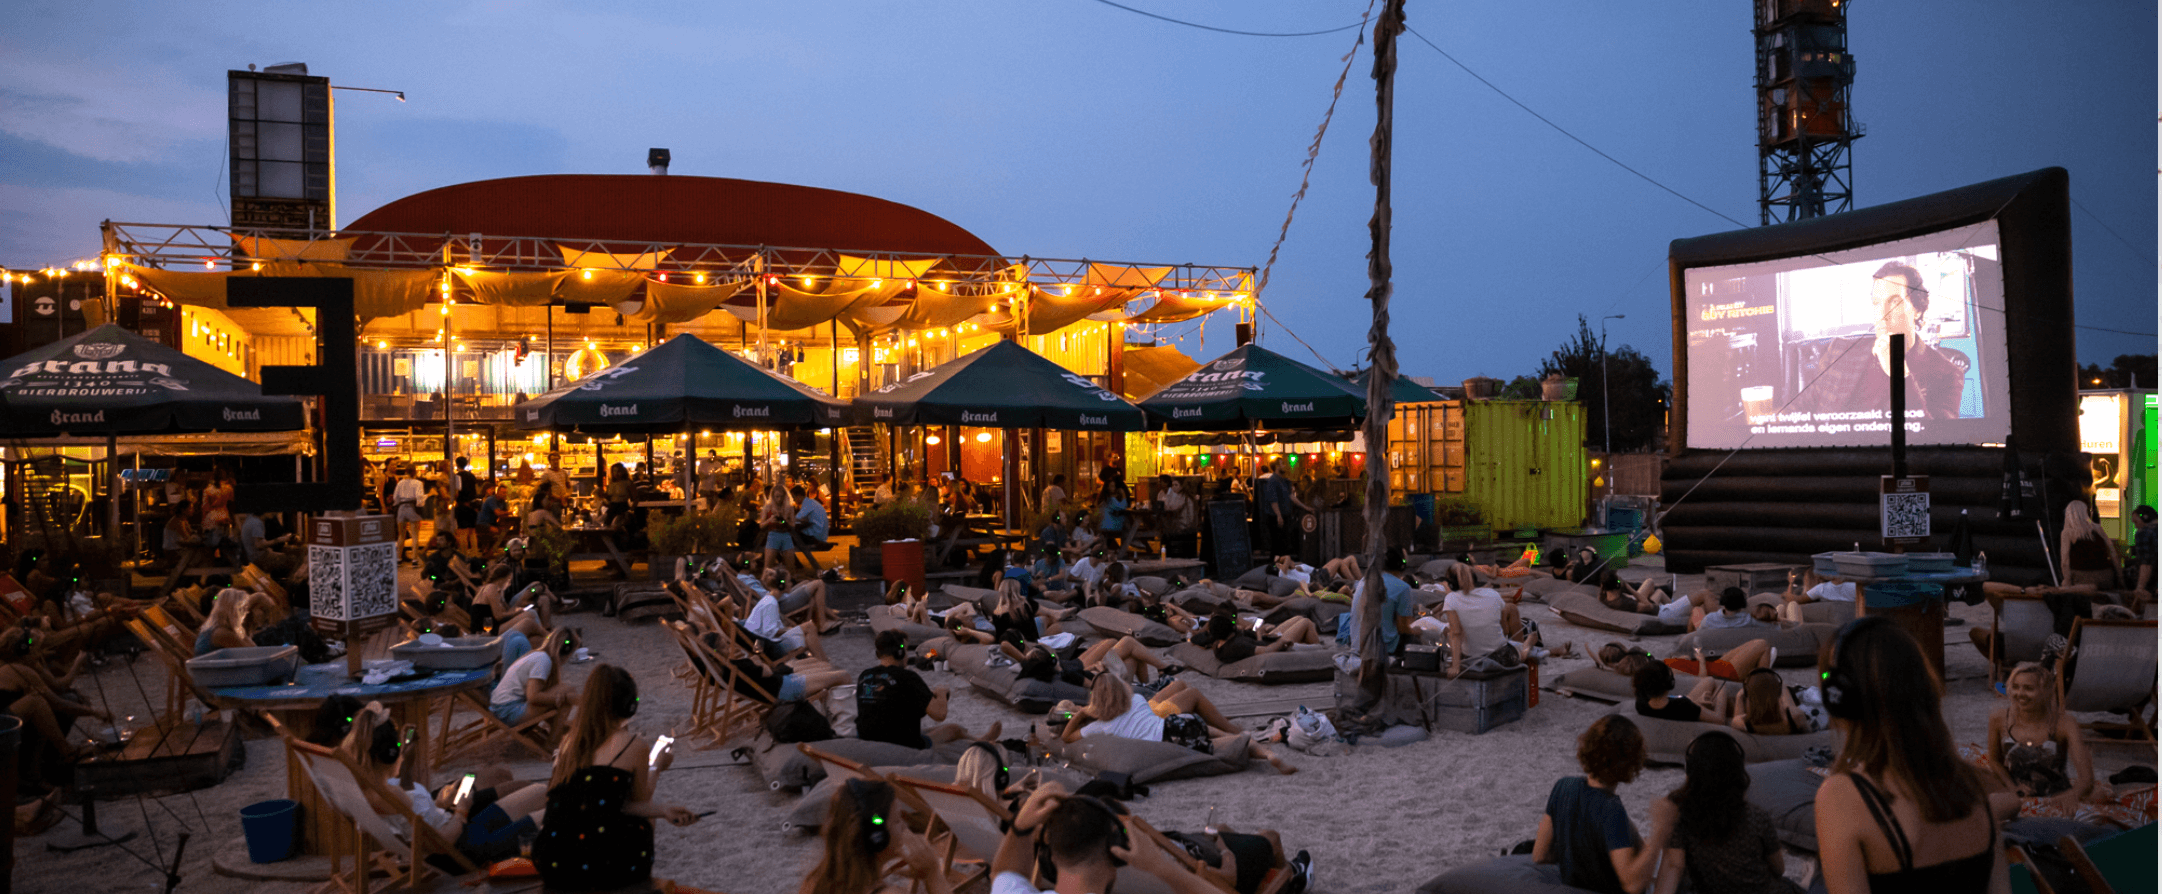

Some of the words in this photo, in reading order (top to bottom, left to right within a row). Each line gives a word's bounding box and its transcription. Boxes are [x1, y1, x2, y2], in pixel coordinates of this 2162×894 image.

[1727, 305, 1774, 318] RITCHIE
[1183, 369, 1266, 383] rand
[63, 379, 112, 388] 1340
[18, 387, 149, 397] BIERBROUWERIJ
[223, 406, 261, 421] Brand
[600, 404, 639, 417] Brand
[733, 405, 770, 418] Brand
[1172, 406, 1203, 419] Brand
[1281, 402, 1315, 414] Brand
[50, 409, 106, 425] Brand
[961, 410, 998, 423] Brand
[1079, 412, 1108, 426] Brand
[1777, 411, 1811, 424] twijfel
[1813, 409, 1883, 421] veroorzaakt
[1885, 409, 1925, 419] cos
[1750, 425, 1766, 434] en
[1767, 423, 1816, 434] iemands
[1817, 422, 1851, 434] eigen
[1853, 421, 1926, 433] onderng.
